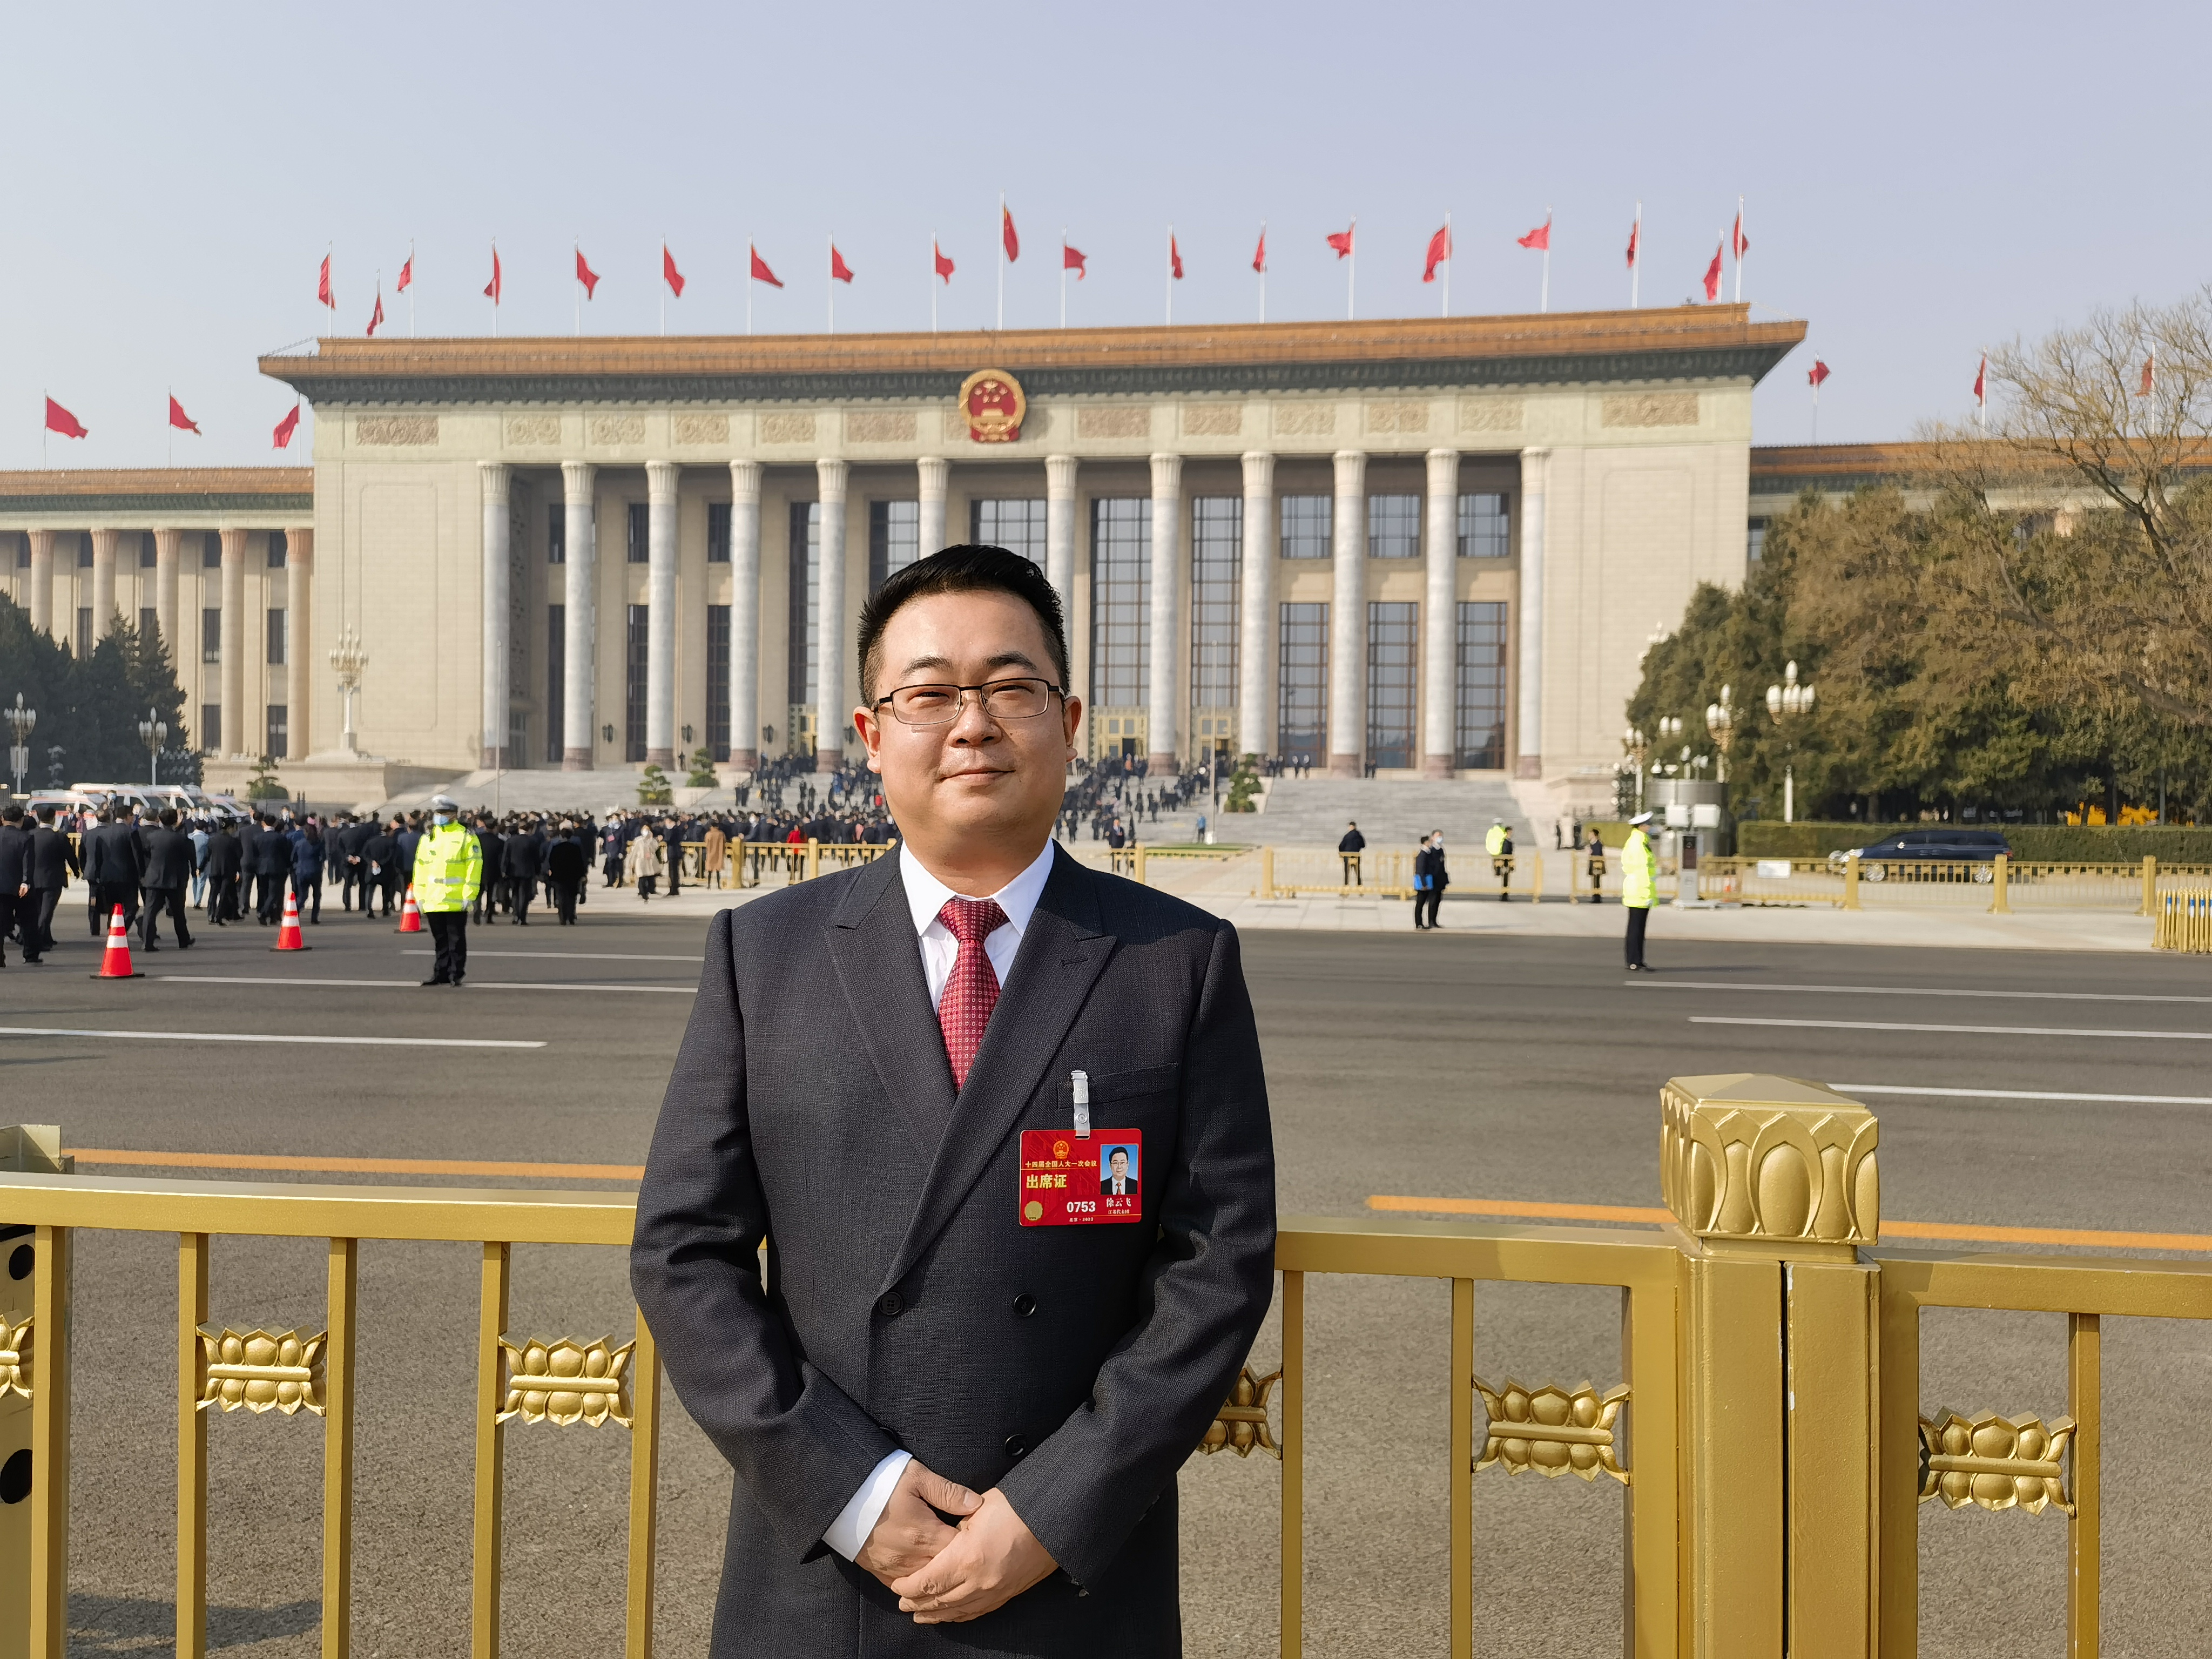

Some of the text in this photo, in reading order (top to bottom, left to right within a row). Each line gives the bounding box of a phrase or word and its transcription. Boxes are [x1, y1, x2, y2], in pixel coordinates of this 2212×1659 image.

[1027, 1174, 1067, 1189] 出席证
[1067, 1201, 1096, 1212] 0753
